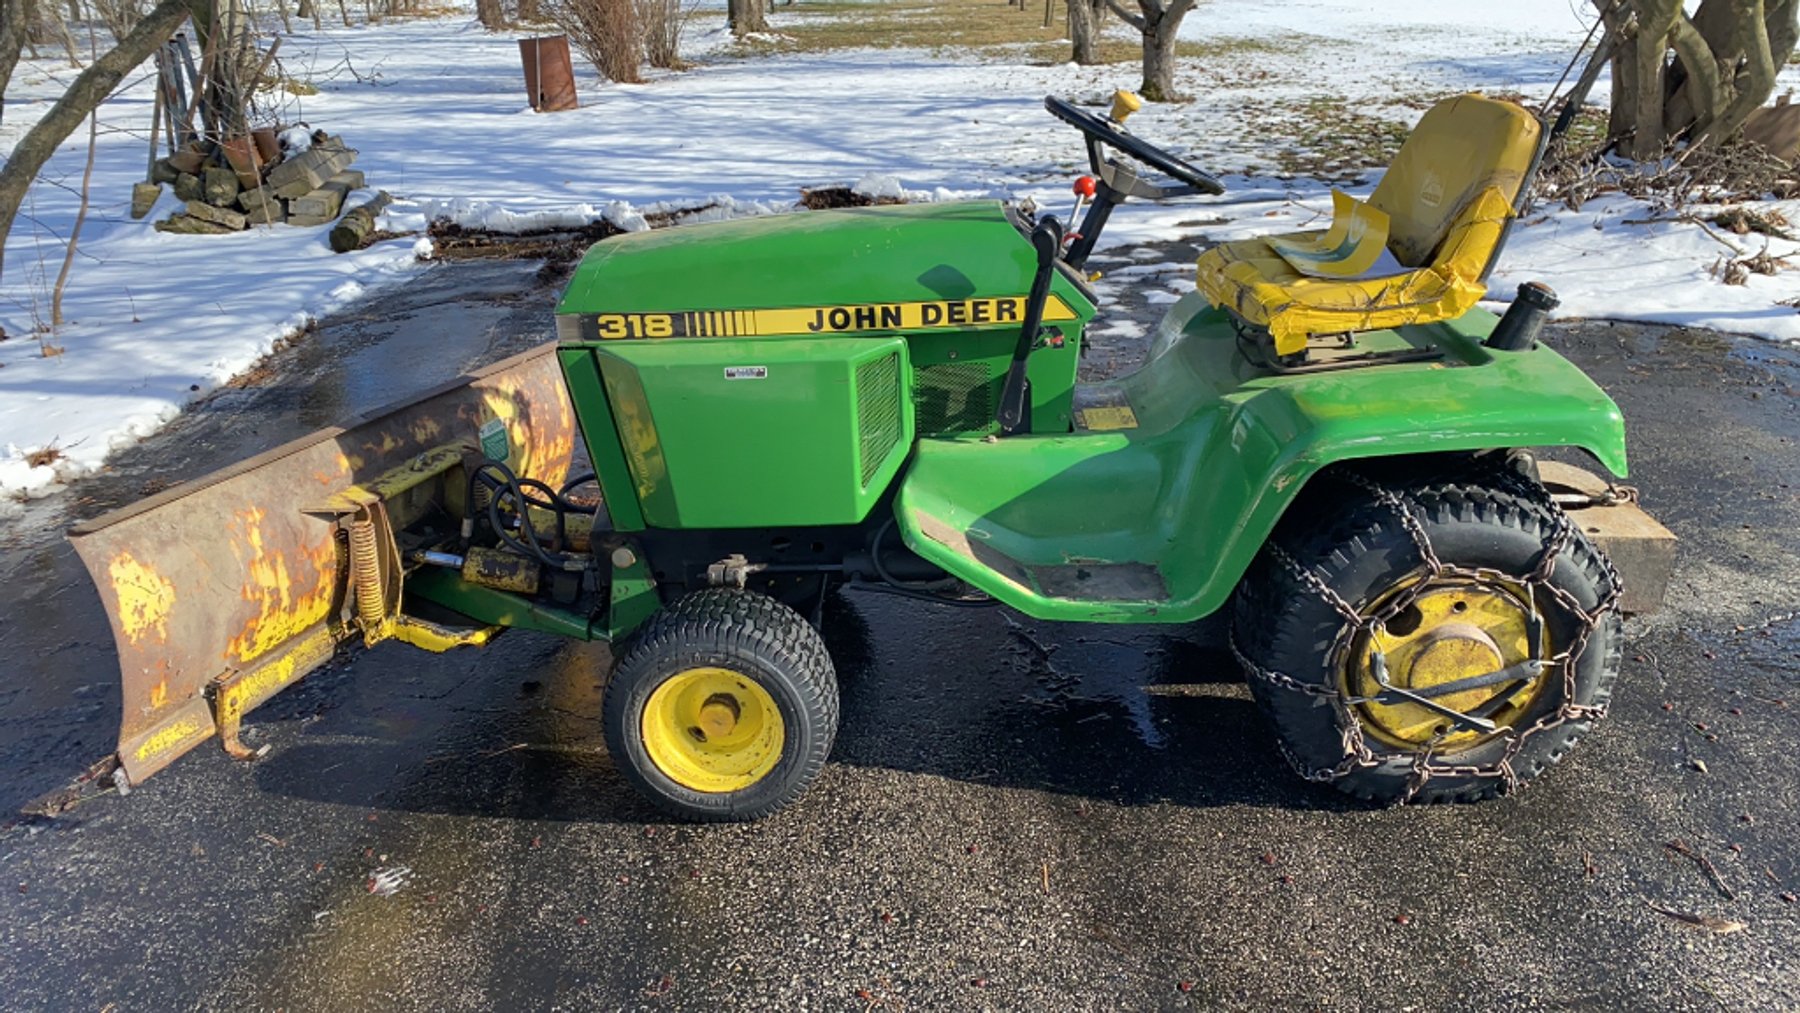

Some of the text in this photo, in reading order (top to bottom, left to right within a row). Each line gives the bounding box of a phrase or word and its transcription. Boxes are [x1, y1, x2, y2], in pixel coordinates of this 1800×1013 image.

[597, 314, 673, 339] 318
[807, 298, 1030, 331] JOHN DEER
